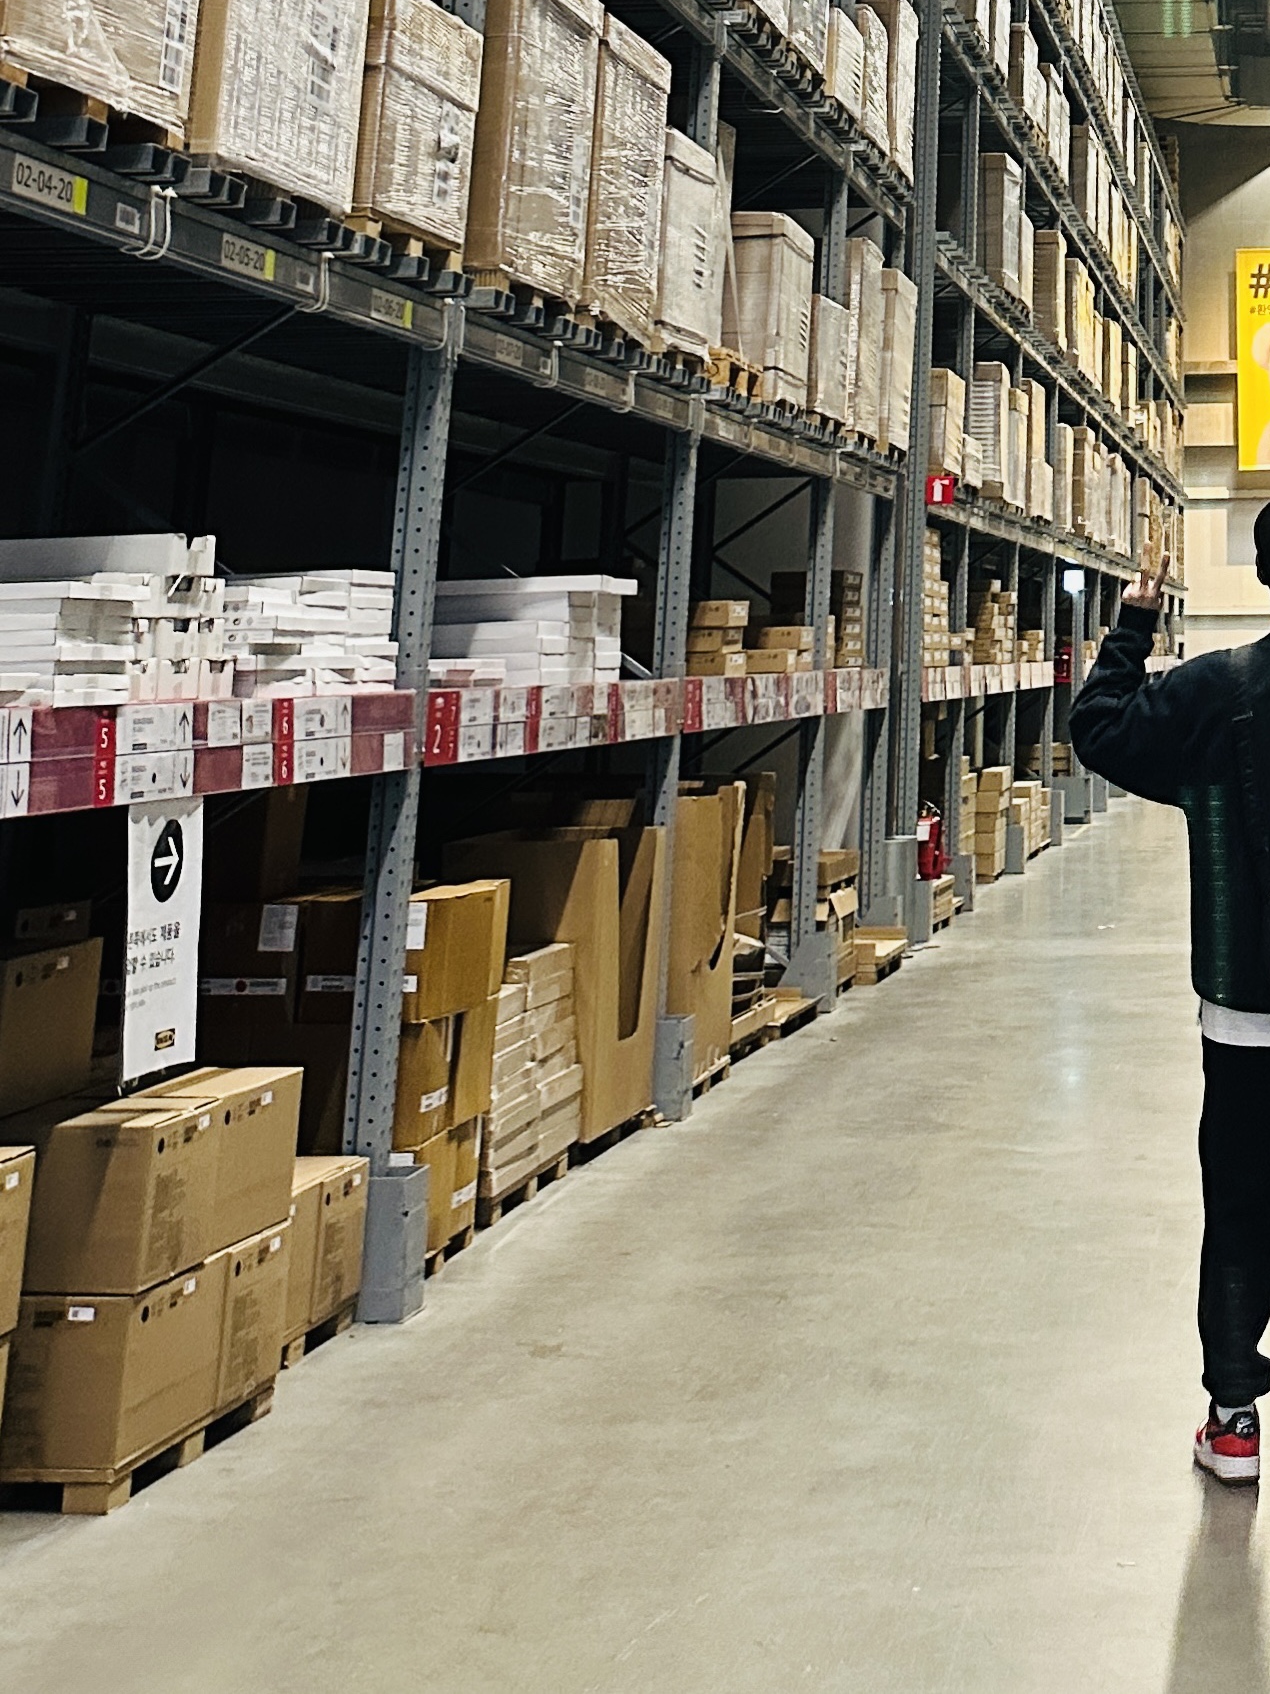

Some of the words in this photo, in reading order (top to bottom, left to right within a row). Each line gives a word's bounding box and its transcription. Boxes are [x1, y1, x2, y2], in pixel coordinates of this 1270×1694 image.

[16, 162, 74, 203] 02-04-20
[223, 239, 266, 272] 02-05-20
[100, 727, 109, 748] 5
[433, 724, 441, 754] 2
[98, 779, 107, 800] 5
